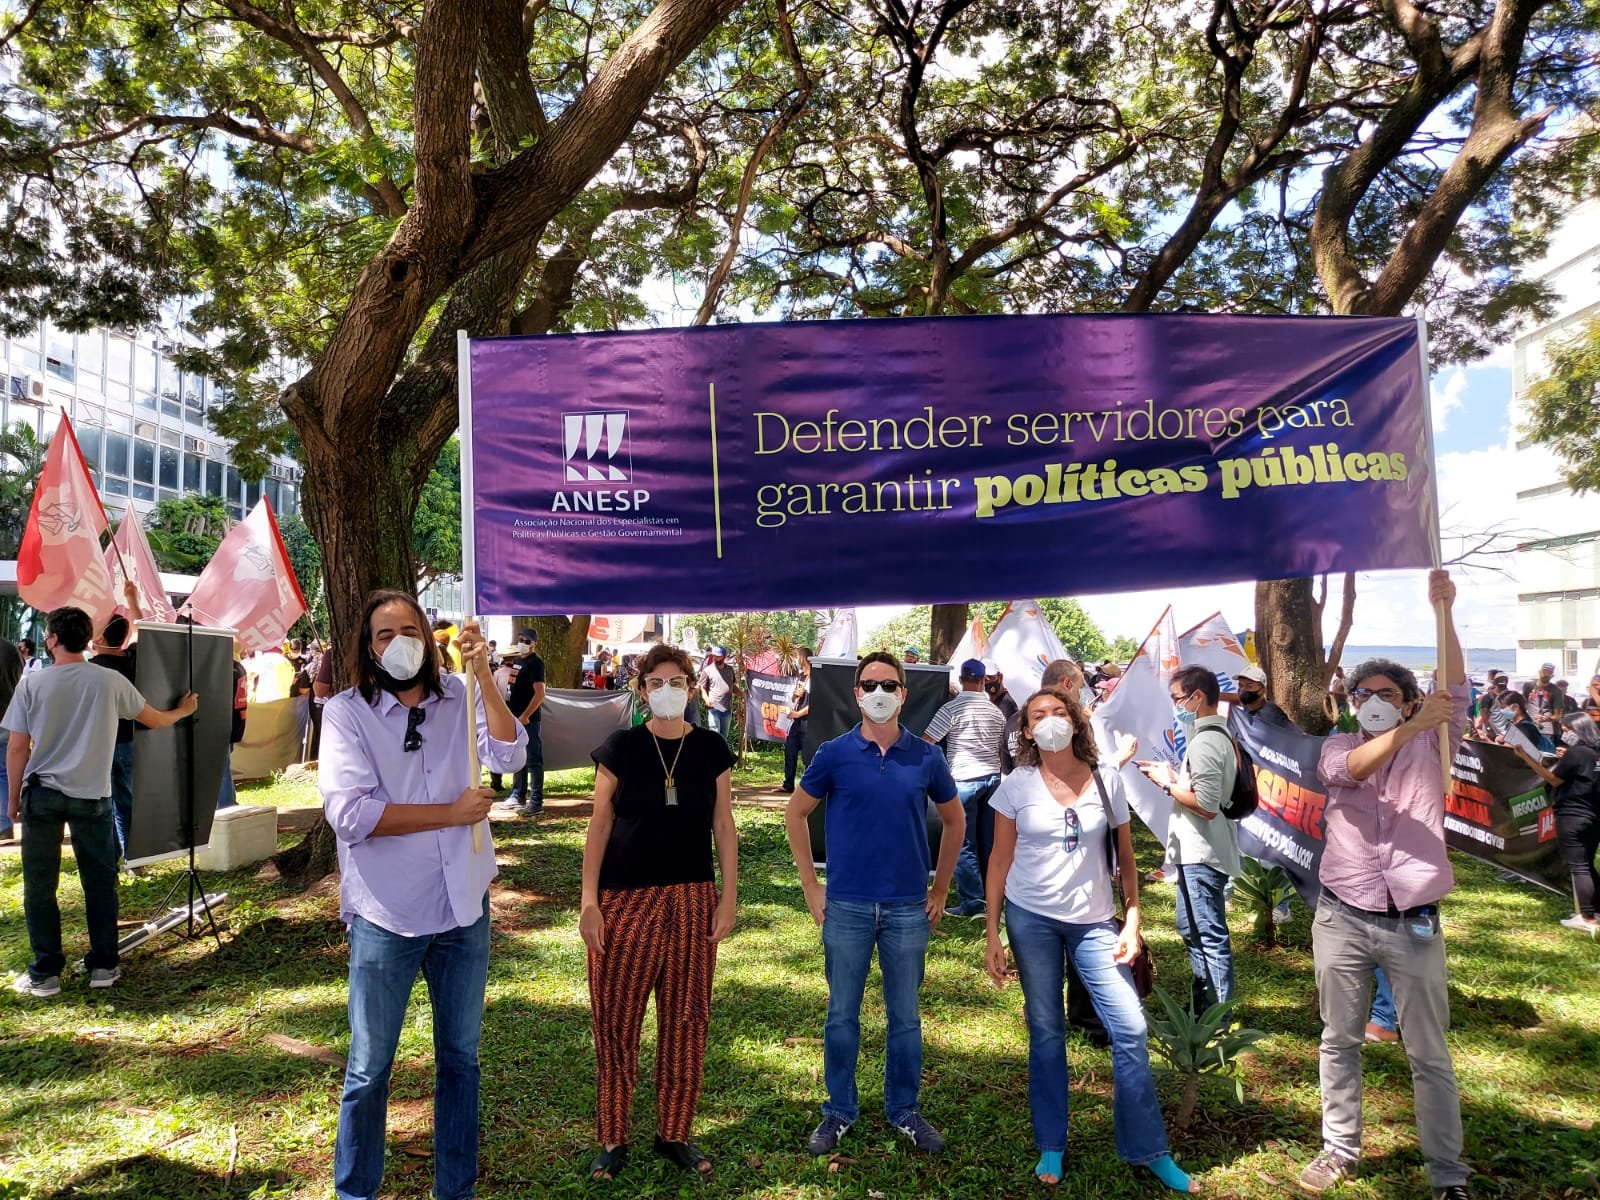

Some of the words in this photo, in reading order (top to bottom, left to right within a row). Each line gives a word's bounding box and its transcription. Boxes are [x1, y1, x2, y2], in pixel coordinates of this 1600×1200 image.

[753, 406, 992, 455] Defender
[1007, 400, 1246, 446] servidores
[1257, 398, 1355, 439] para
[756, 468, 960, 527] garantir
[974, 459, 1209, 518] políticas
[1218, 443, 1408, 499] públicas
[551, 489, 650, 512] ANESP
[512, 530, 545, 539] Políticas
[588, 528, 617, 538] Gestão
[618, 527, 683, 537] Governamental
[514, 518, 559, 528] Associação
[560, 517, 595, 526] Nacional
[597, 517, 611, 526] dos
[613, 516, 664, 527] Especialistas
[666, 517, 679, 525] em
[1252, 764, 1327, 840] SPEITE
[1512, 795, 1547, 818] NEGOCIA
